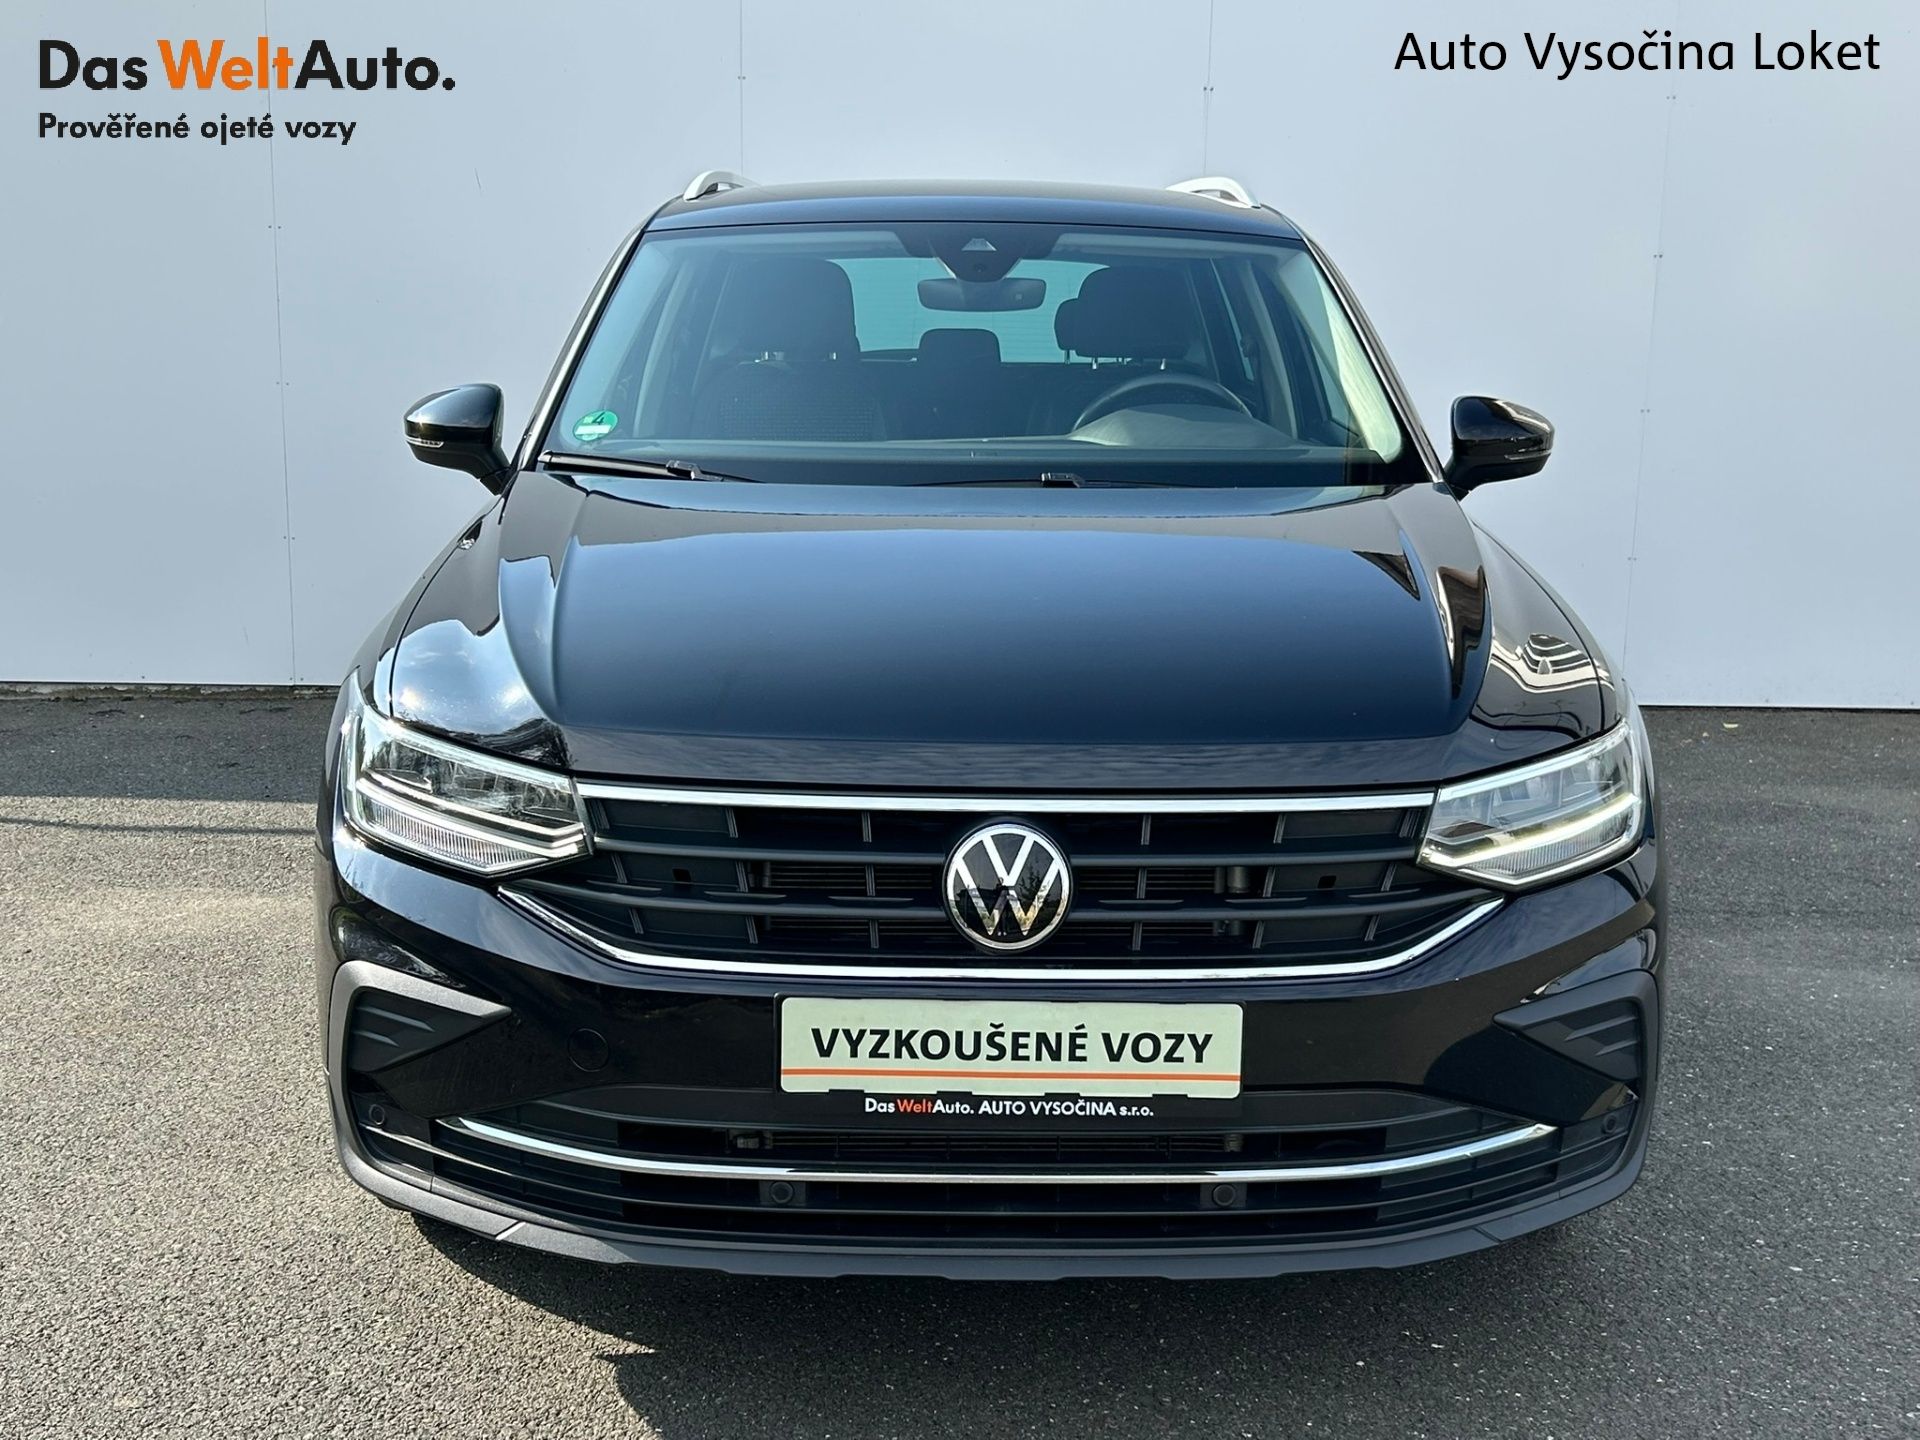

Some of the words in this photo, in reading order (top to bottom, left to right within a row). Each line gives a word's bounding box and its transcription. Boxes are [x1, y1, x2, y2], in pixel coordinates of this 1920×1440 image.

[591, 411, 605, 426] 4
[810, 1022, 1088, 1063] VYZKOUŠENÉ
[1101, 1032, 1213, 1064] VOZY
[978, 1100, 1026, 1115] AUTO
[1029, 1098, 1117, 1116] VYSOČINA
[1119, 1106, 1154, 1117] s.r.o.
